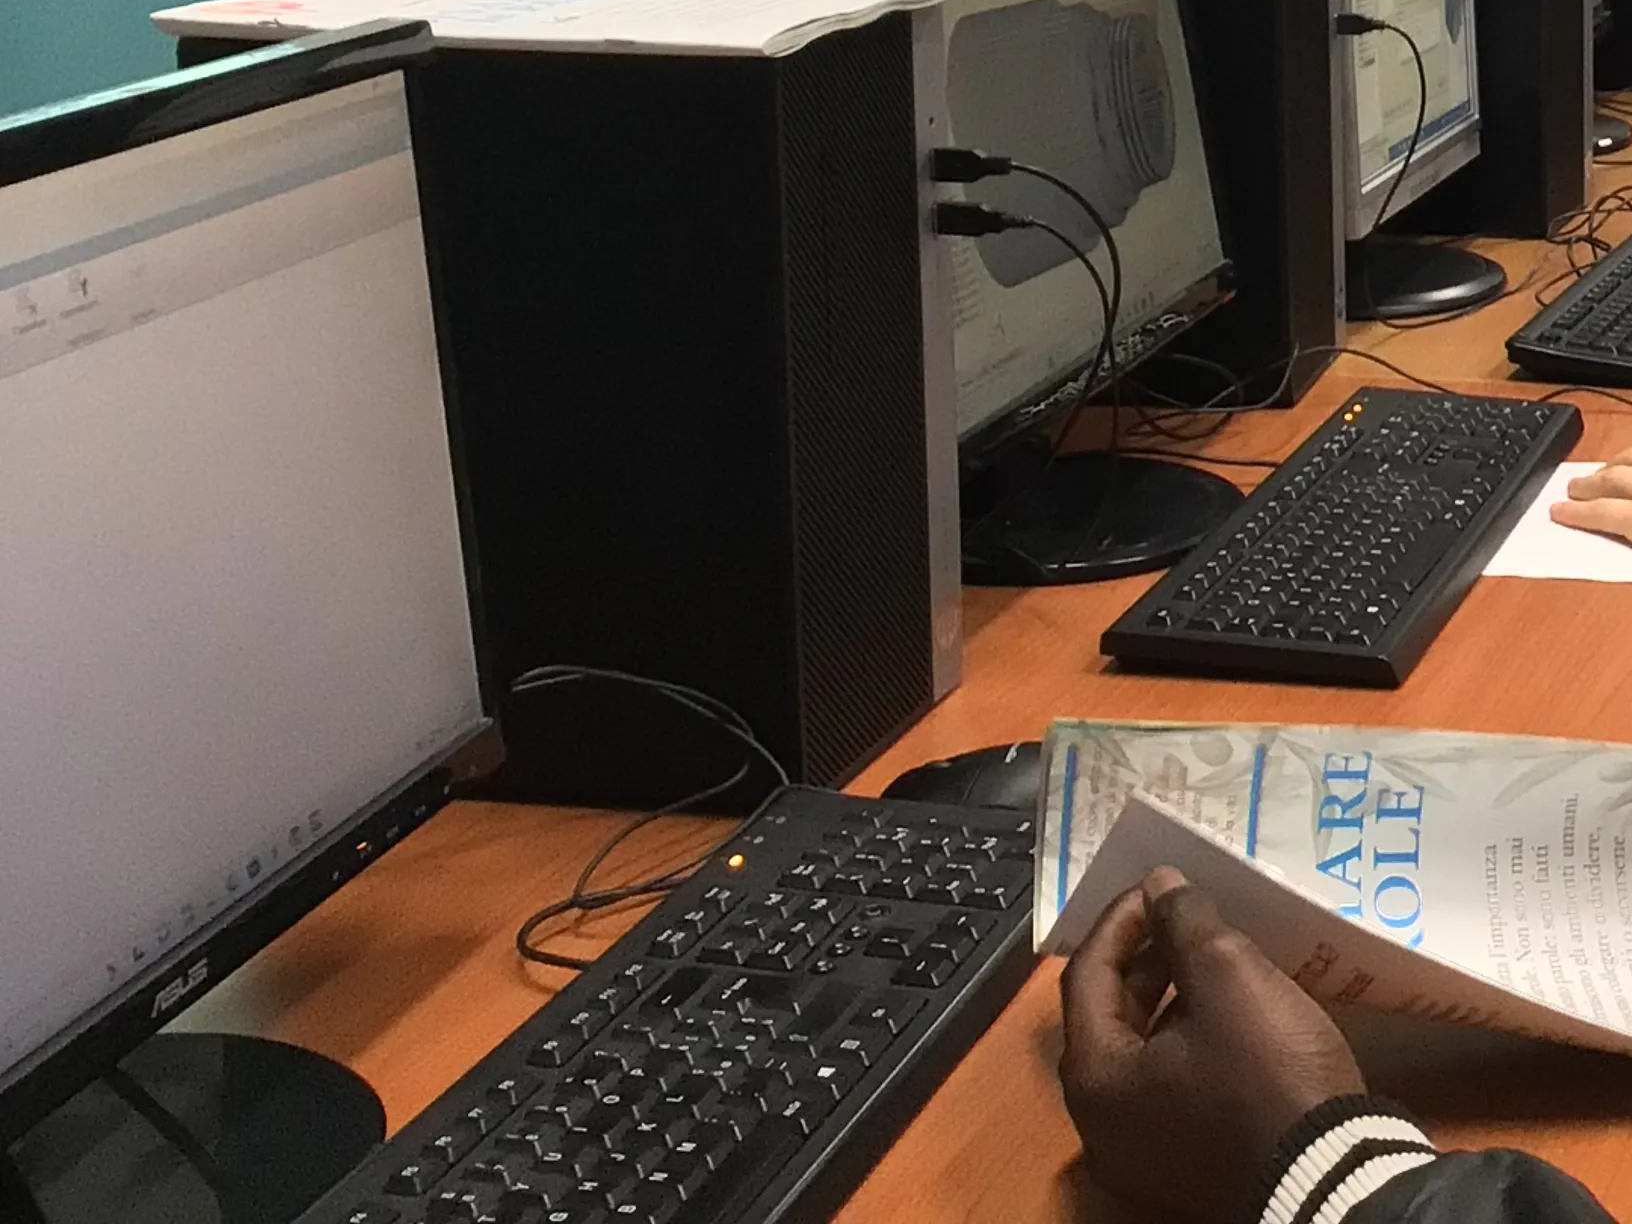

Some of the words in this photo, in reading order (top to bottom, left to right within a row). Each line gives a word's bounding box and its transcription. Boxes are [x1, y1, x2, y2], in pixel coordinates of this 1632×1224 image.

[1315, 751, 1373, 918] ARE
[1505, 837, 1524, 875] mai
[1561, 793, 1580, 858] umani.
[1373, 785, 1425, 950] OLE
[1531, 844, 1551, 884] fatti
[1515, 927, 1534, 962] Non
[150, 957, 208, 1018] ASUS
